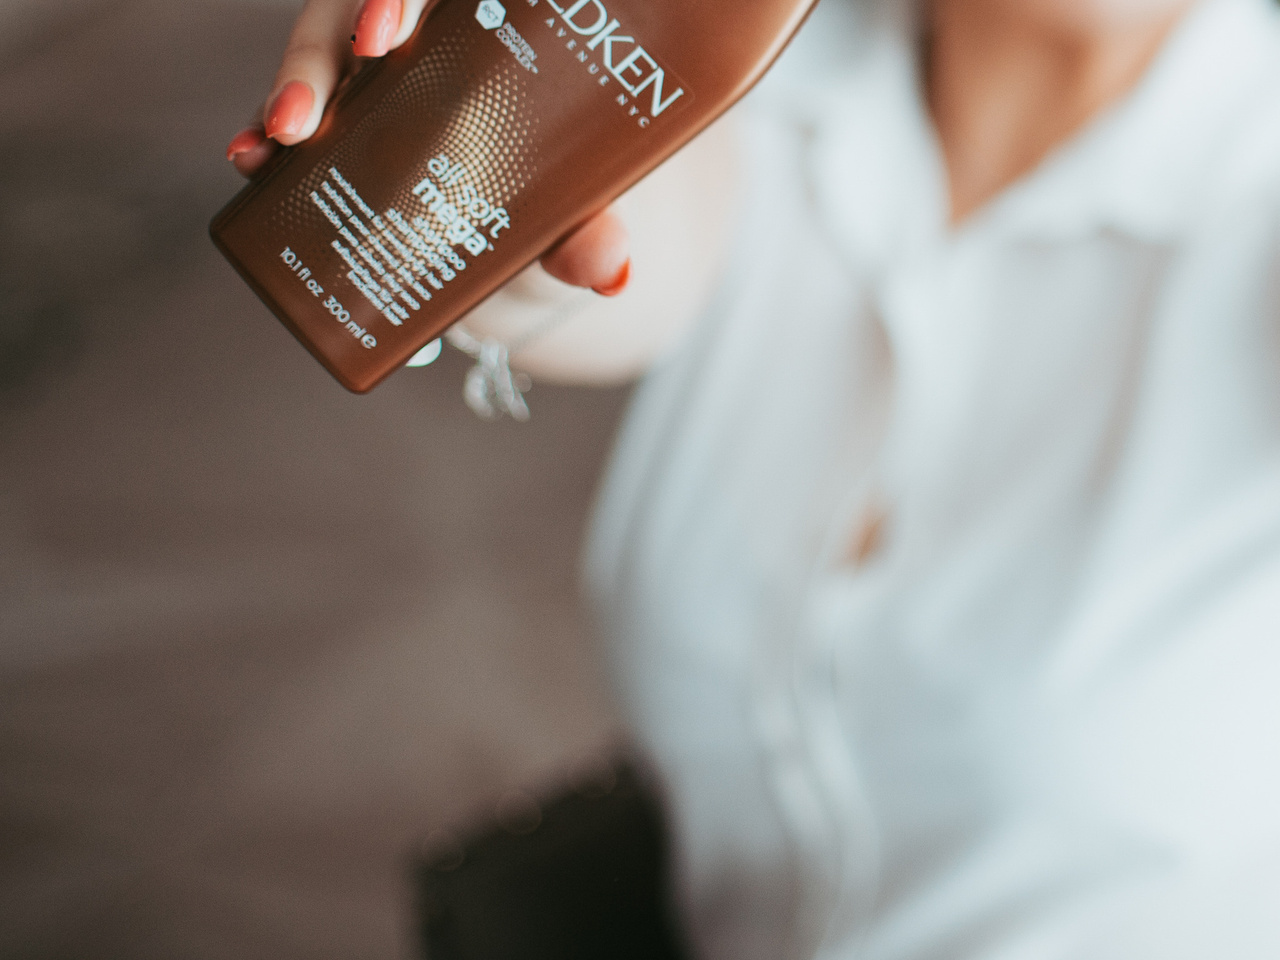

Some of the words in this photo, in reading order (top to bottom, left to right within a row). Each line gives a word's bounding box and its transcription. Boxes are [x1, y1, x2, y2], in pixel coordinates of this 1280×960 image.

[500, 23, 537, 61] PROTEIN
[546, 18, 609, 86] AVENUE
[616, 93, 649, 127] NYC
[428, 154, 466, 190] all
[453, 180, 510, 238] soft
[280, 247, 302, 271] 10.1
[297, 267, 311, 281] fl
[307, 279, 324, 297] oz
[323, 295, 350, 322] 300
[345, 320, 366, 338] ml
